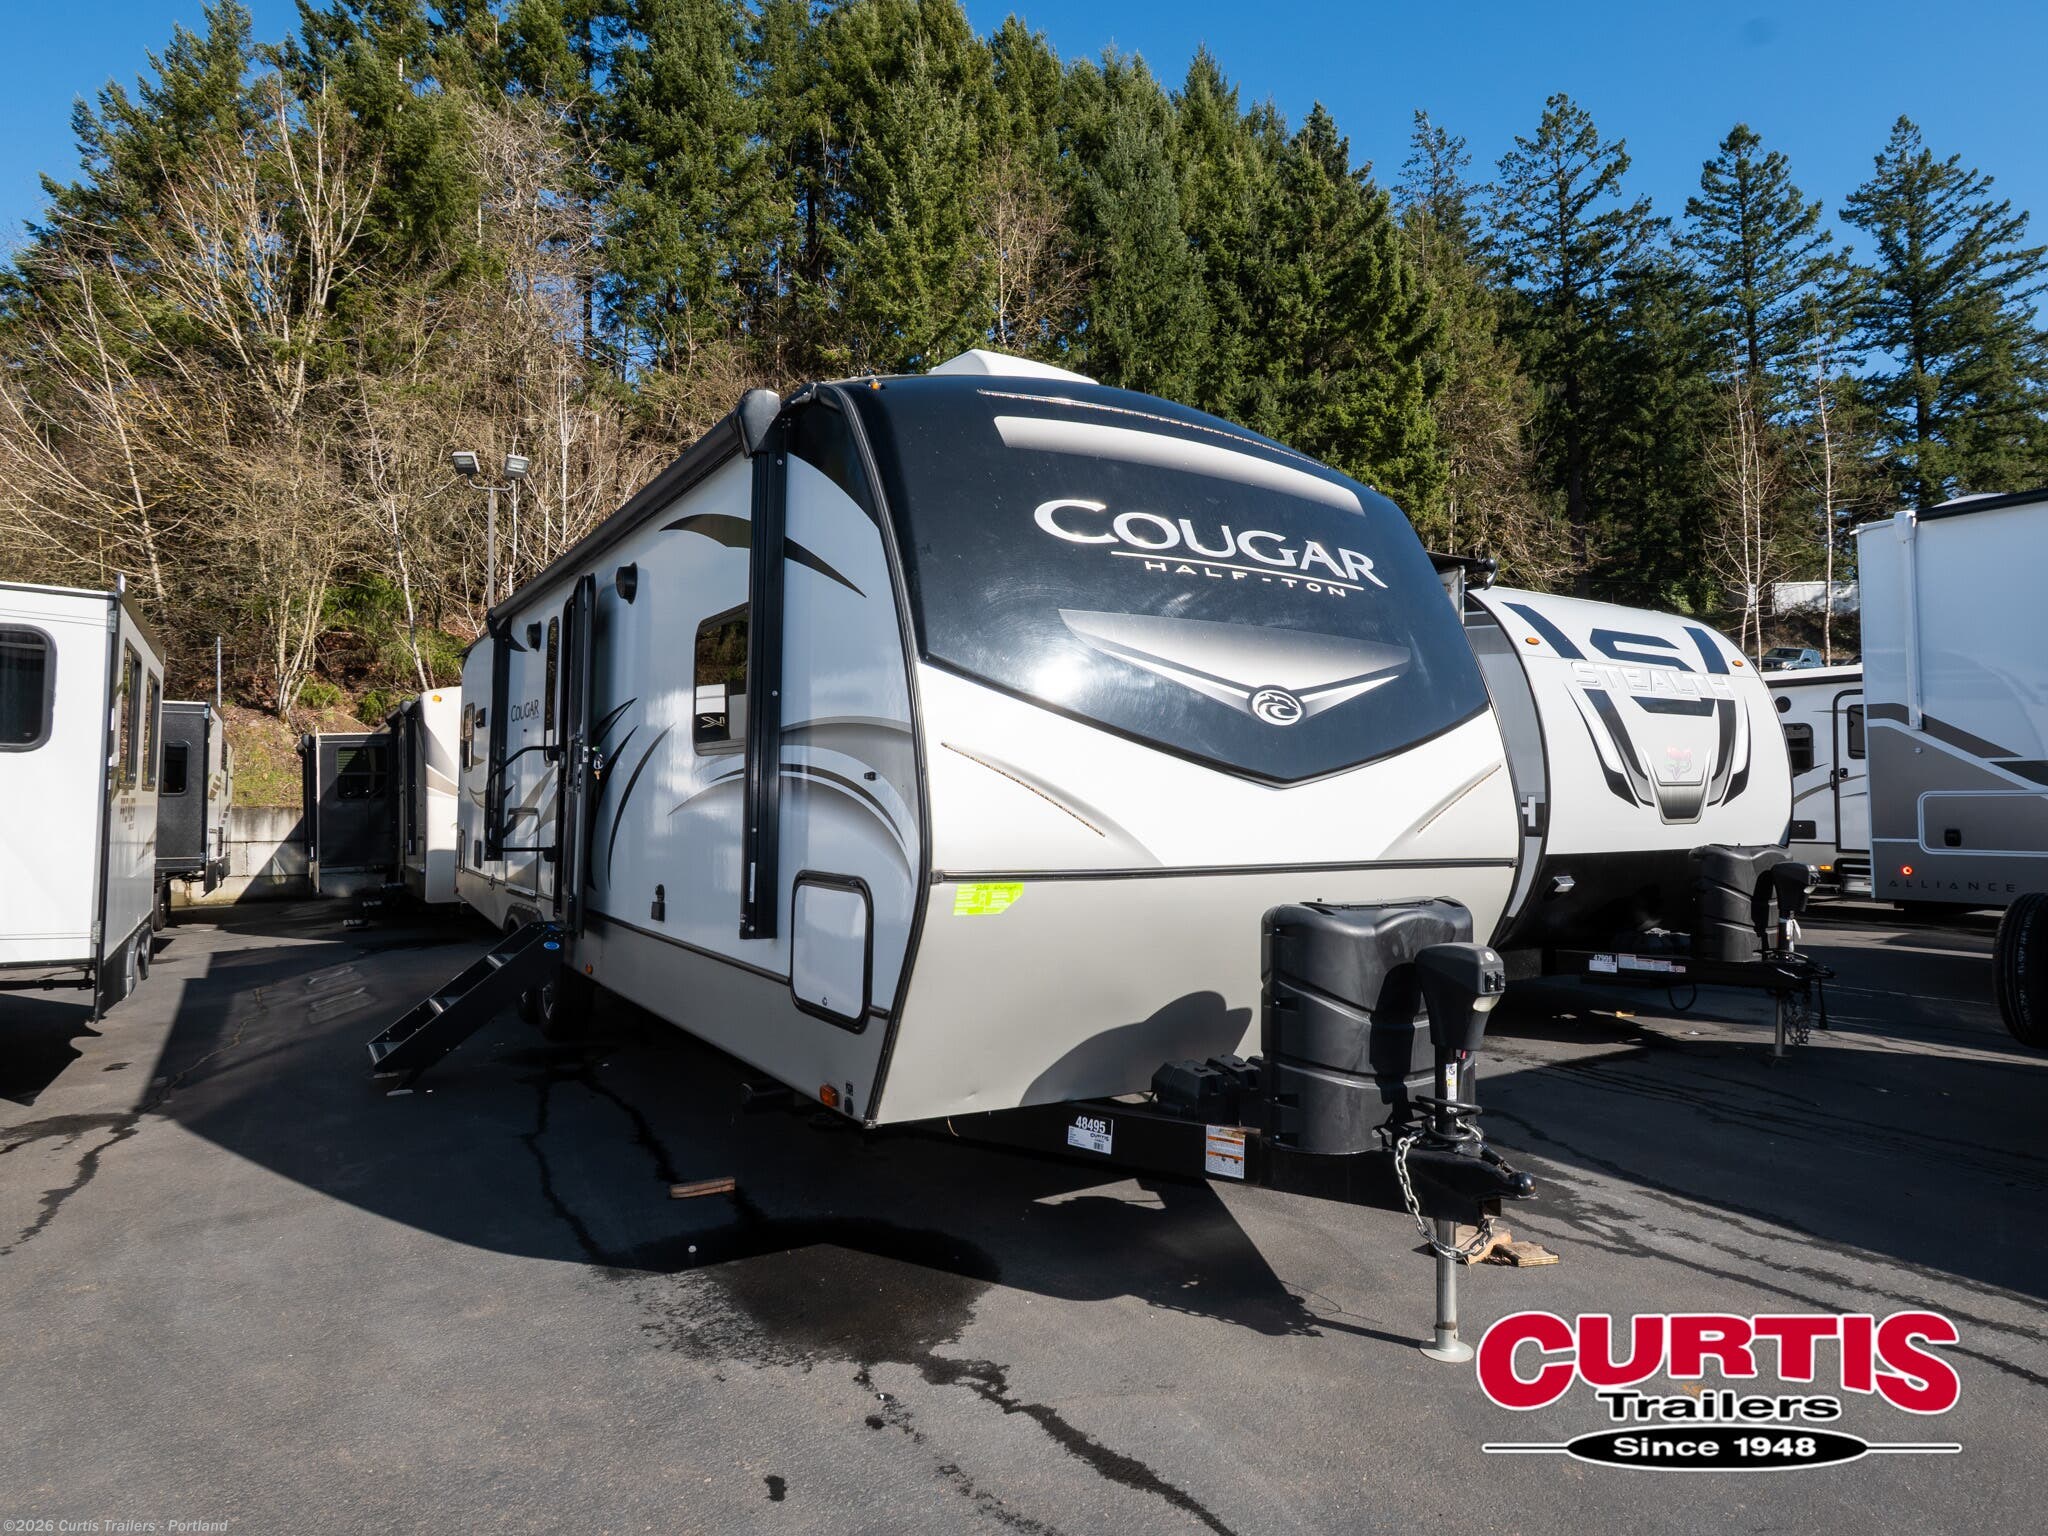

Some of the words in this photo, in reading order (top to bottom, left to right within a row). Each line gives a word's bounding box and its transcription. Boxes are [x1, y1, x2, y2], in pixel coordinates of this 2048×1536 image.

[1034, 499, 1389, 589] COUGAR
[1574, 662, 1736, 699] STEALTH
[511, 699, 539, 722] COUGAR
[1887, 879, 2017, 893] ALLIANCE
[1075, 1115, 1106, 1134] 48495
